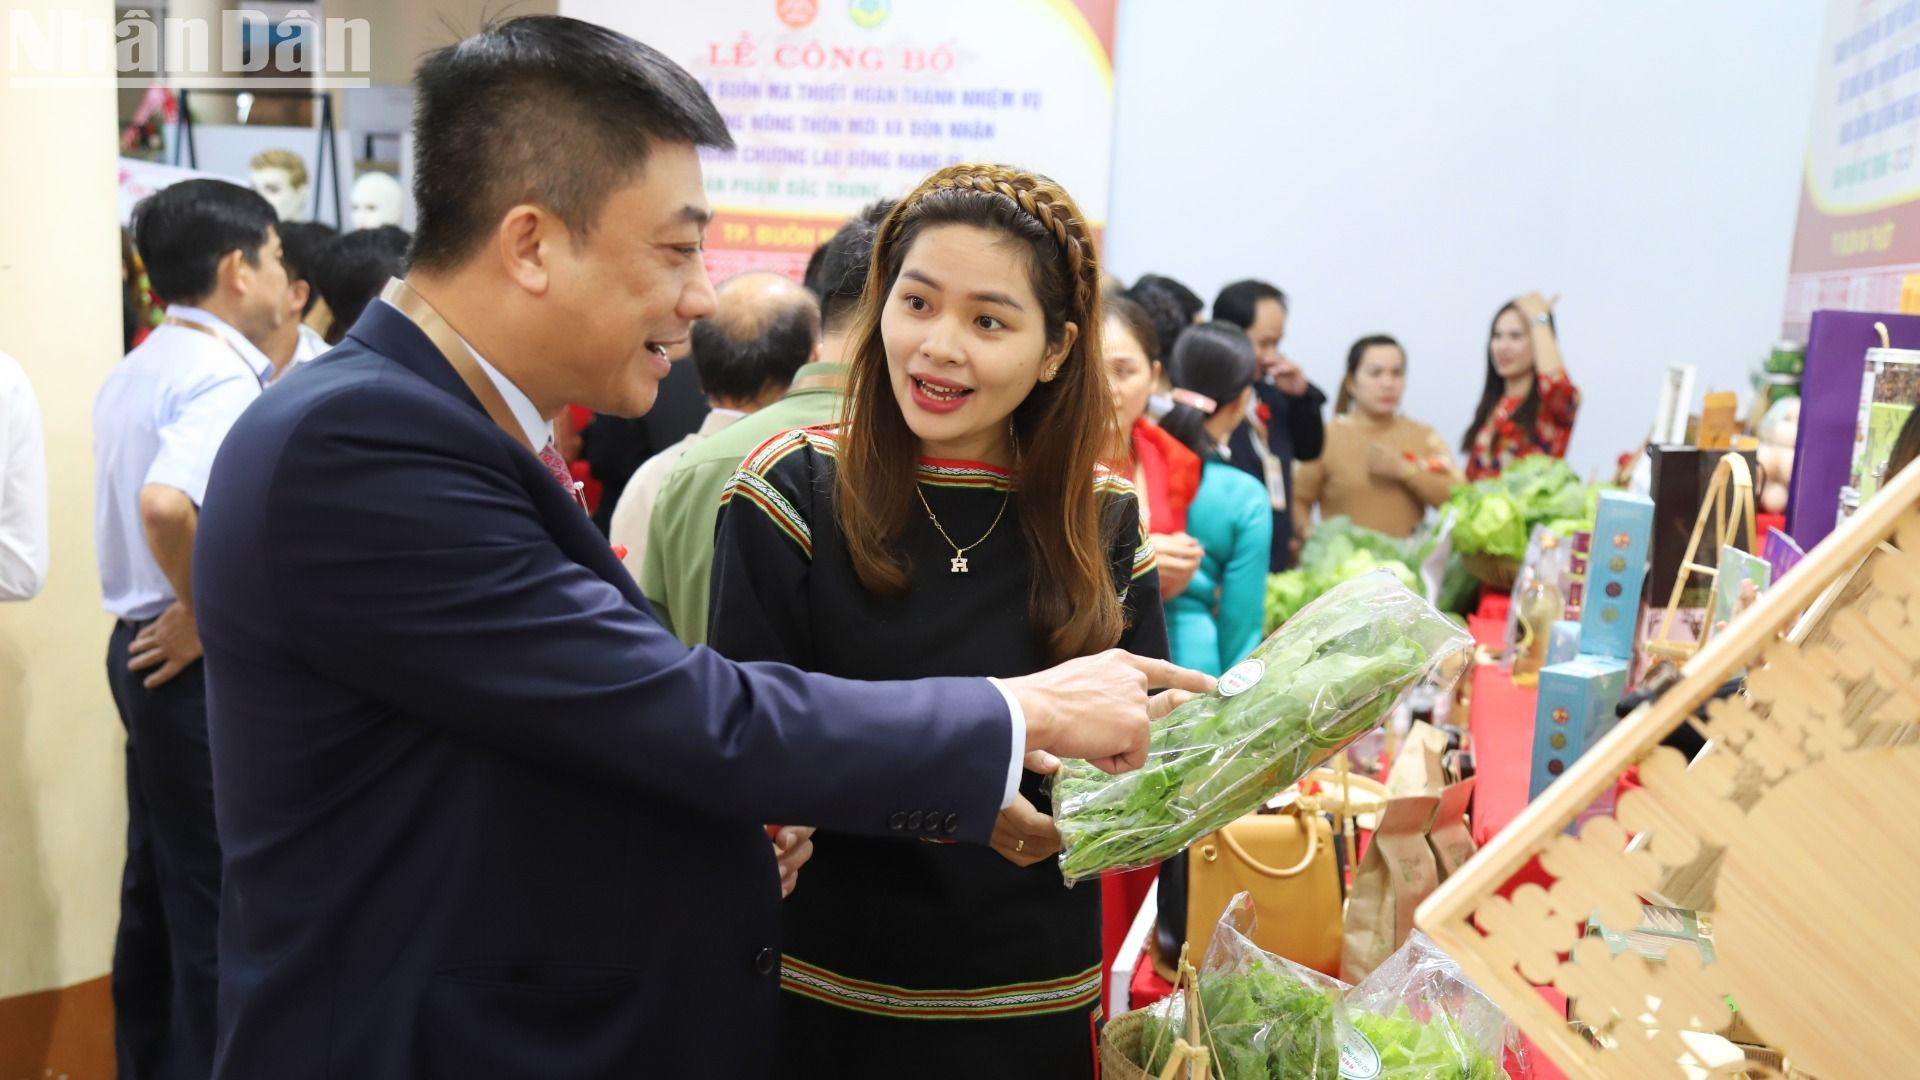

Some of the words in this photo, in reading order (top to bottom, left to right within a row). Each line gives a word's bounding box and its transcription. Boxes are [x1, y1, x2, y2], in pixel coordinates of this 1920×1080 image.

[708, 31, 758, 68] LỄ
[773, 39, 886, 72] CÔNG
[902, 38, 956, 74] BỐ
[755, 222, 816, 247] BUÔN
